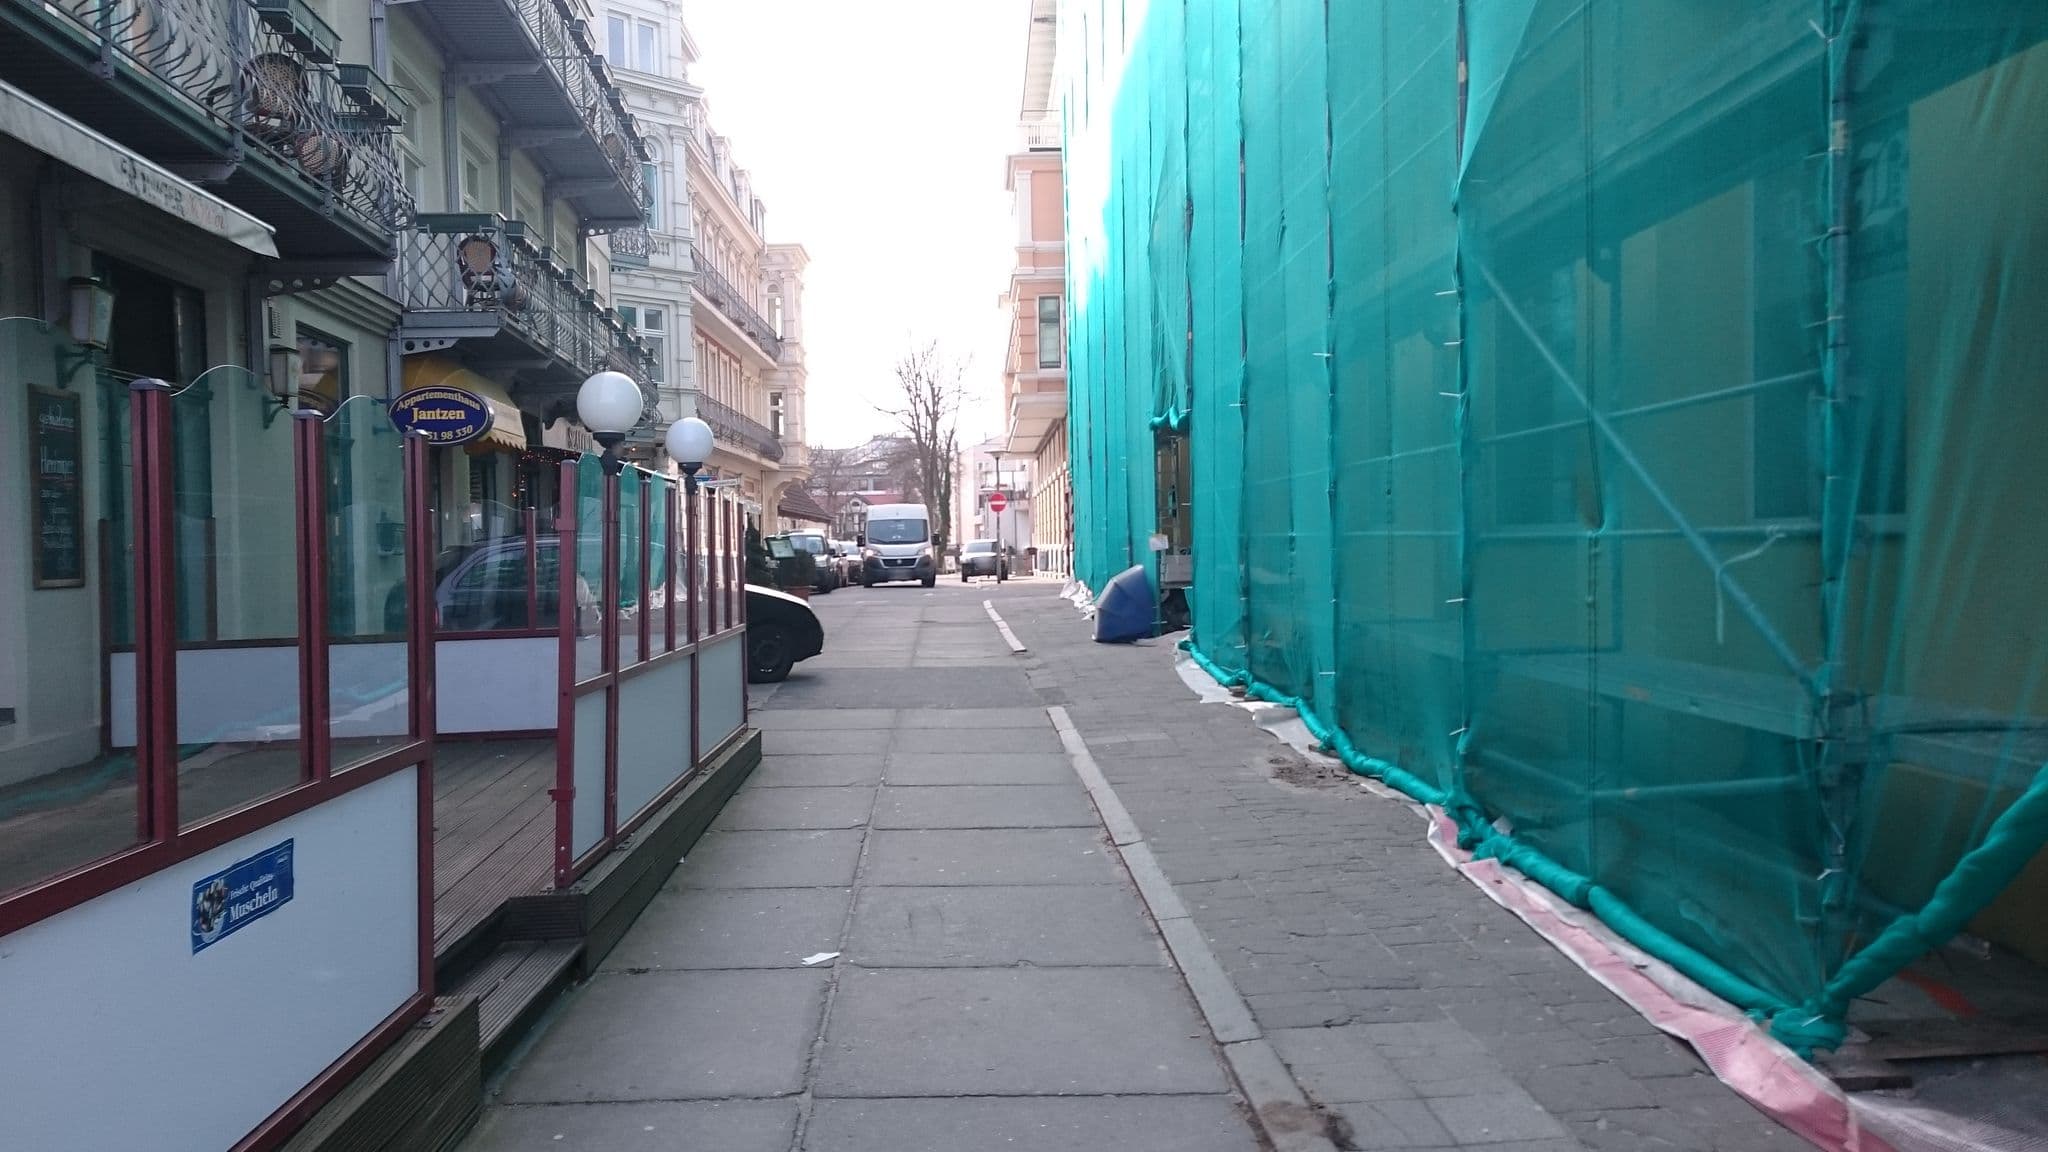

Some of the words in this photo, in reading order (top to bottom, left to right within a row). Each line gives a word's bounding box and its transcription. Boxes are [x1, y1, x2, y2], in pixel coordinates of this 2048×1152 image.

[396, 391, 480, 411] Appartementhaus
[412, 407, 466, 424] Jantzen
[440, 430, 454, 440] 98
[229, 885, 278, 923] Muscheln
